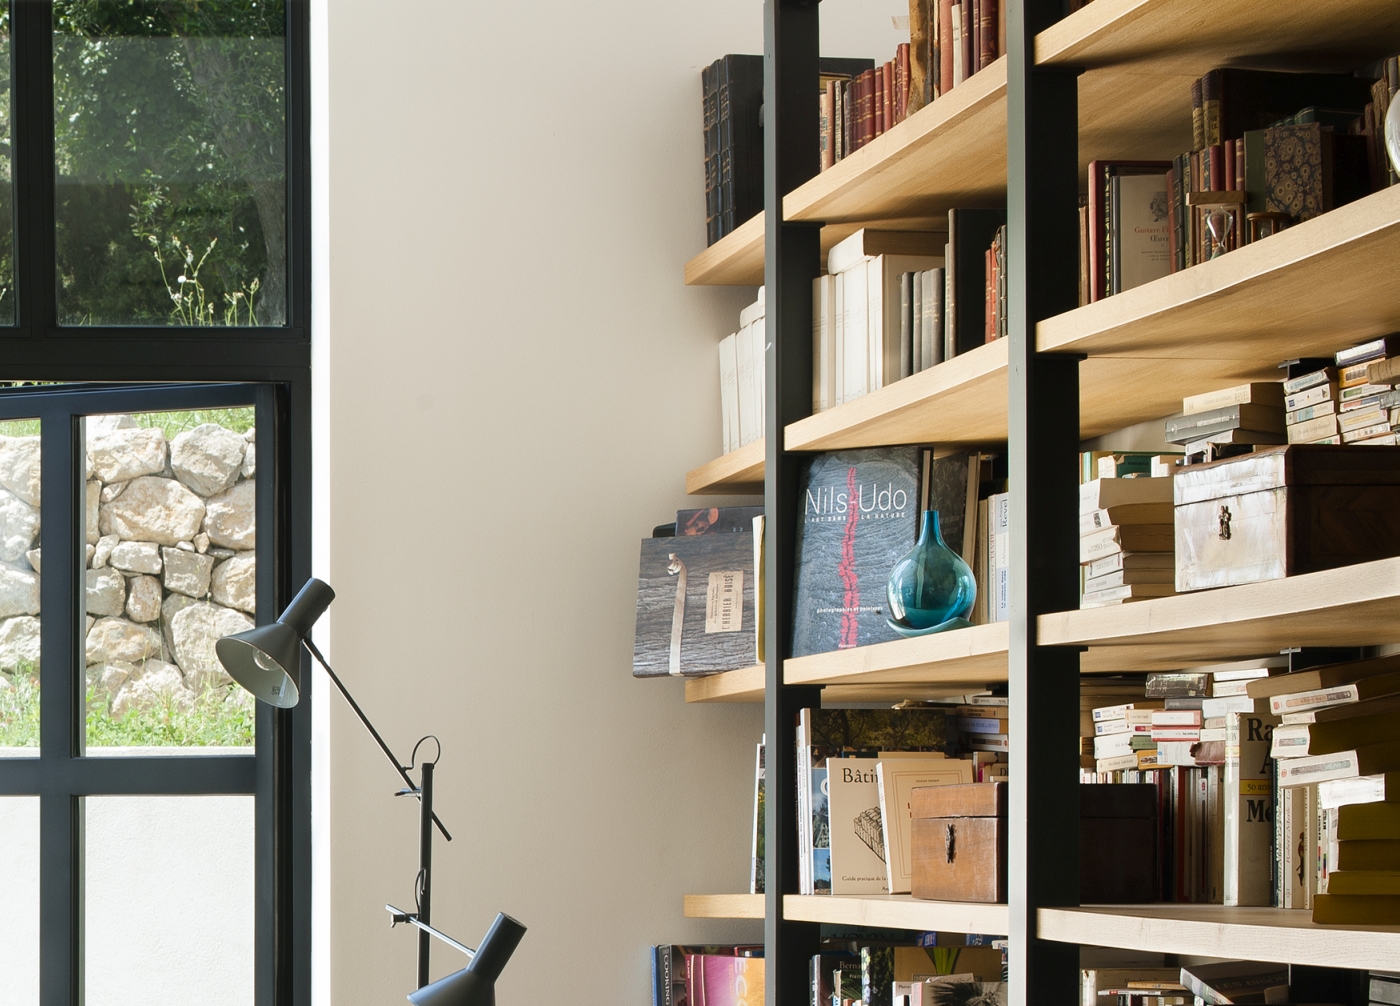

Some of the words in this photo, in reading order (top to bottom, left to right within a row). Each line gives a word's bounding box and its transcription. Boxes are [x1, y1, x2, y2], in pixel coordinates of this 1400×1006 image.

[804, 483, 907, 516] Nils-Udo
[827, 515, 847, 523] DANS
[723, 574, 734, 593] BOISÉ
[722, 597, 732, 630] L'HERBIER
[856, 875, 875, 883] pratique
[663, 954, 672, 1005] COOKING
